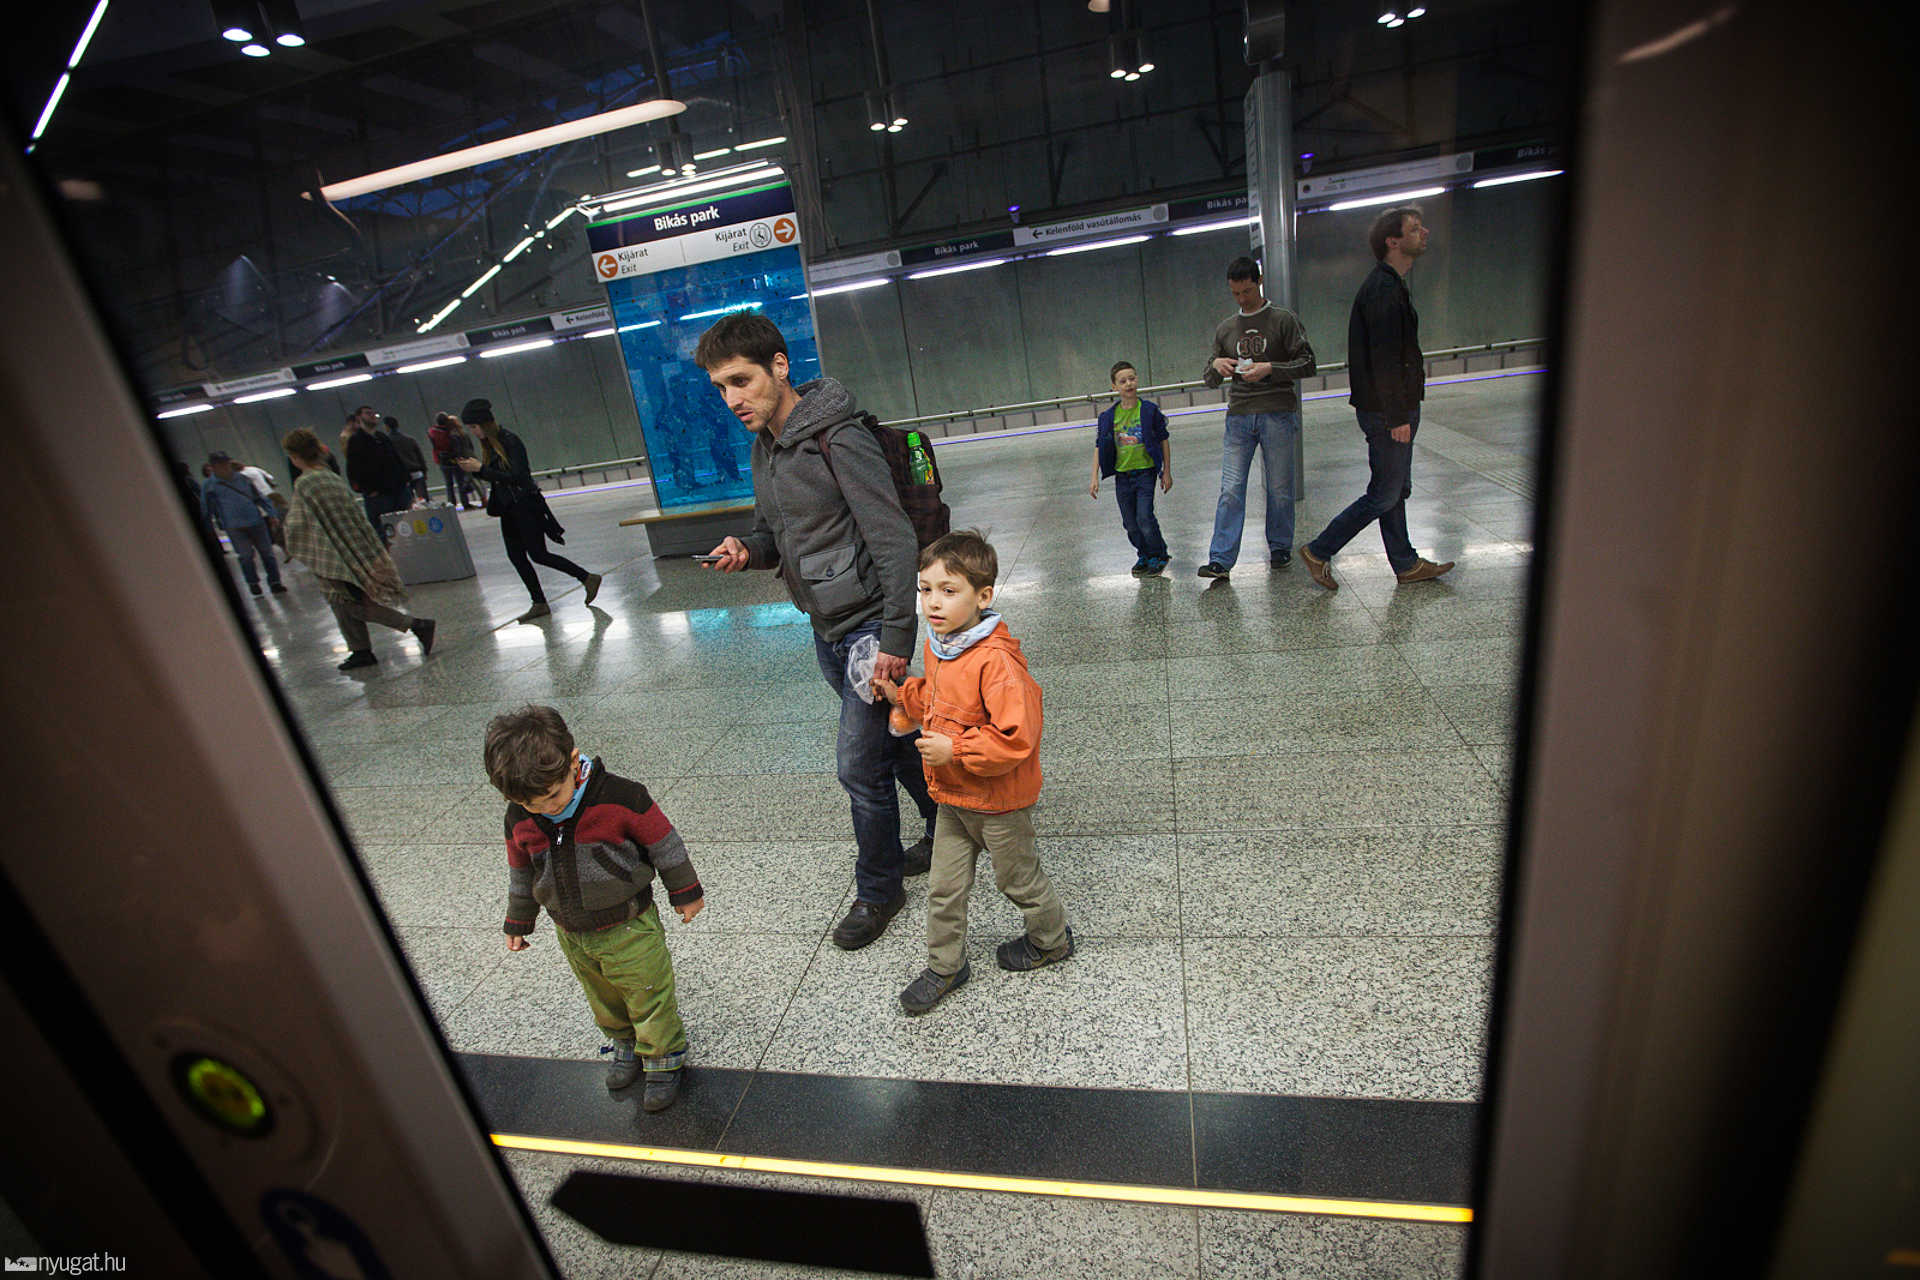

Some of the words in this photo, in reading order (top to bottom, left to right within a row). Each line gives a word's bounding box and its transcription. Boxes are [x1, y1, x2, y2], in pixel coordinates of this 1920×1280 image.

[1234, 196, 1248, 208] pa
[653, 211, 688, 231] Bikás
[690, 205, 720, 228] park
[1045, 221, 1085, 236] Kelenföld
[1086, 212, 1142, 230] vasútállomás
[715, 228, 748, 242] Kijárat
[732, 241, 750, 252] Exit
[934, 243, 958, 256] Bikás
[959, 240, 979, 253] park
[617, 247, 650, 262] Kijárat
[621, 263, 638, 274] Exit
